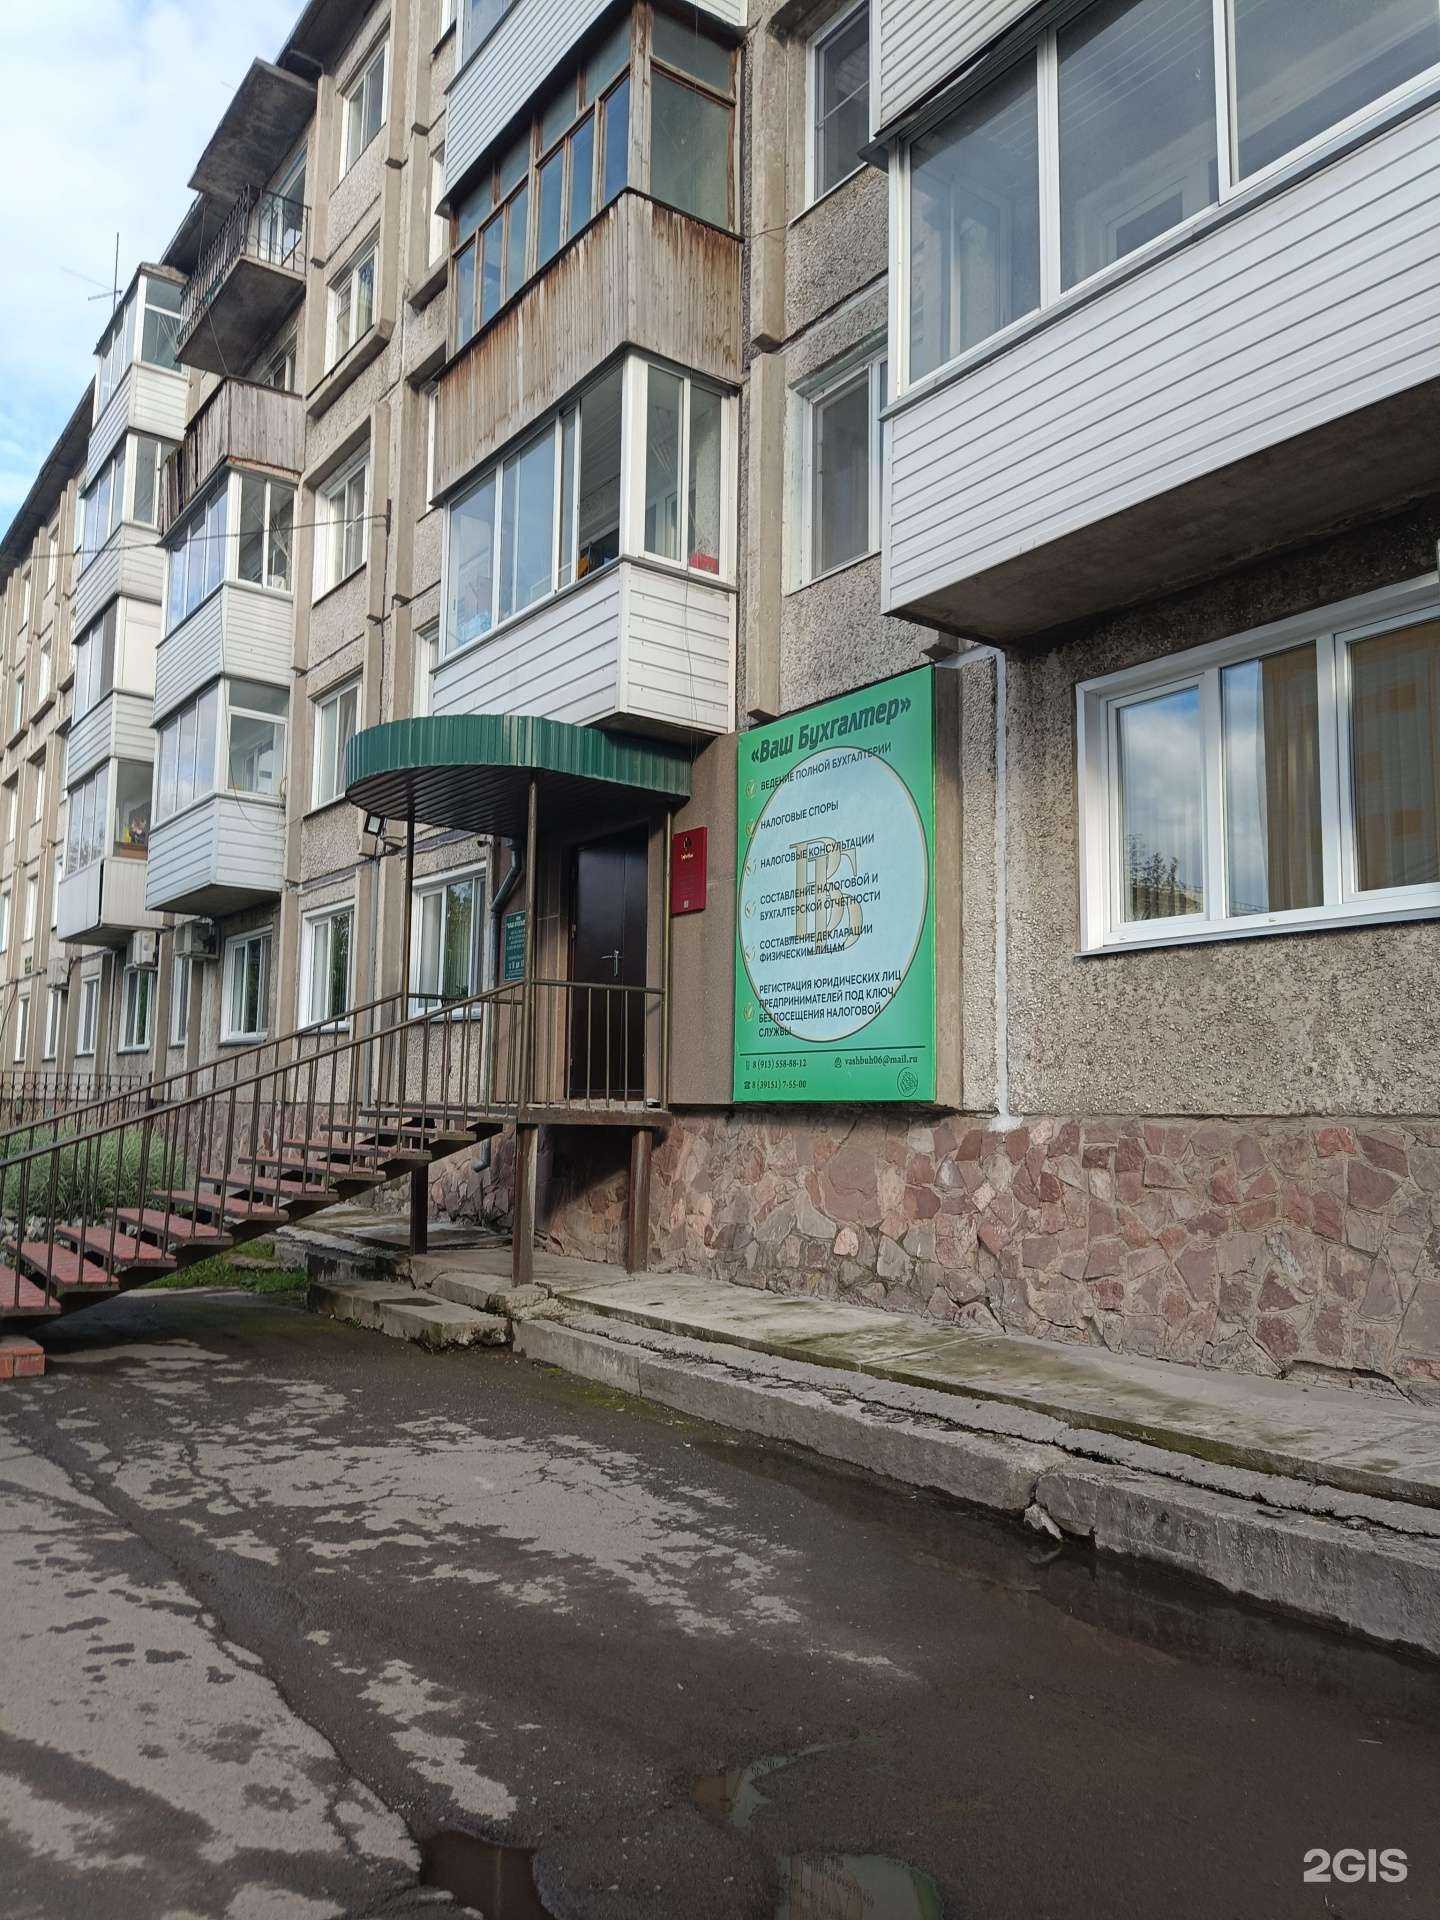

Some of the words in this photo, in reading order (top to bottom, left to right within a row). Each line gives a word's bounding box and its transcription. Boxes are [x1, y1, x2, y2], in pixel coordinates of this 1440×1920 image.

[751, 733, 794, 763] «Ваш
[798, 697, 912, 750] Бухгалтер»
[760, 770, 795, 791] ВЕДЕНИЕ
[795, 759, 831, 782] ПОЛНОЙ
[832, 742, 892, 769] БУХГАЛТЕРИИ
[760, 809, 807, 830] НАЛОГОВЫЕ
[808, 800, 839, 817] СПОРЫ
[760, 849, 808, 869] НАЛОГОВЫЕ
[808, 833, 875, 857] КОНСУЛЬТАЦИИ
[760, 884, 816, 905] СОСТАВЛЕНИЕ
[817, 875, 870, 894] НАЛОГОВОЙ
[871, 873, 879, 884] И
[760, 901, 822, 921] БУХГАЛТЕРСКОЙ
[760, 932, 815, 950] СОСТАВЛЕНИЕ
[817, 924, 873, 944] ДЕКЛАРАЦИИ
[759, 948, 816, 963] ФИЗИЧЕСКИМ
[816, 943, 845, 956] ЛИЦАМ
[759, 978, 812, 994] РЕГИСТРАЦИЯ
[813, 972, 881, 990] ЮРИДИЧЕСКИХ
[881, 970, 901, 982] ЛИЦ
[759, 990, 843, 1009] ПРЕДПРИНИМАТЕЛЕЙ
[845, 989, 865, 1002] ПОД
[758, 1012, 773, 1024] БЕЗ
[774, 1007, 825, 1022] ПОСЕЩЕНИЯ
[826, 1003, 881, 1018] НАЛОГОВОЙ
[845, 1054, 918, 1067] vashbuh06@mail.ru
